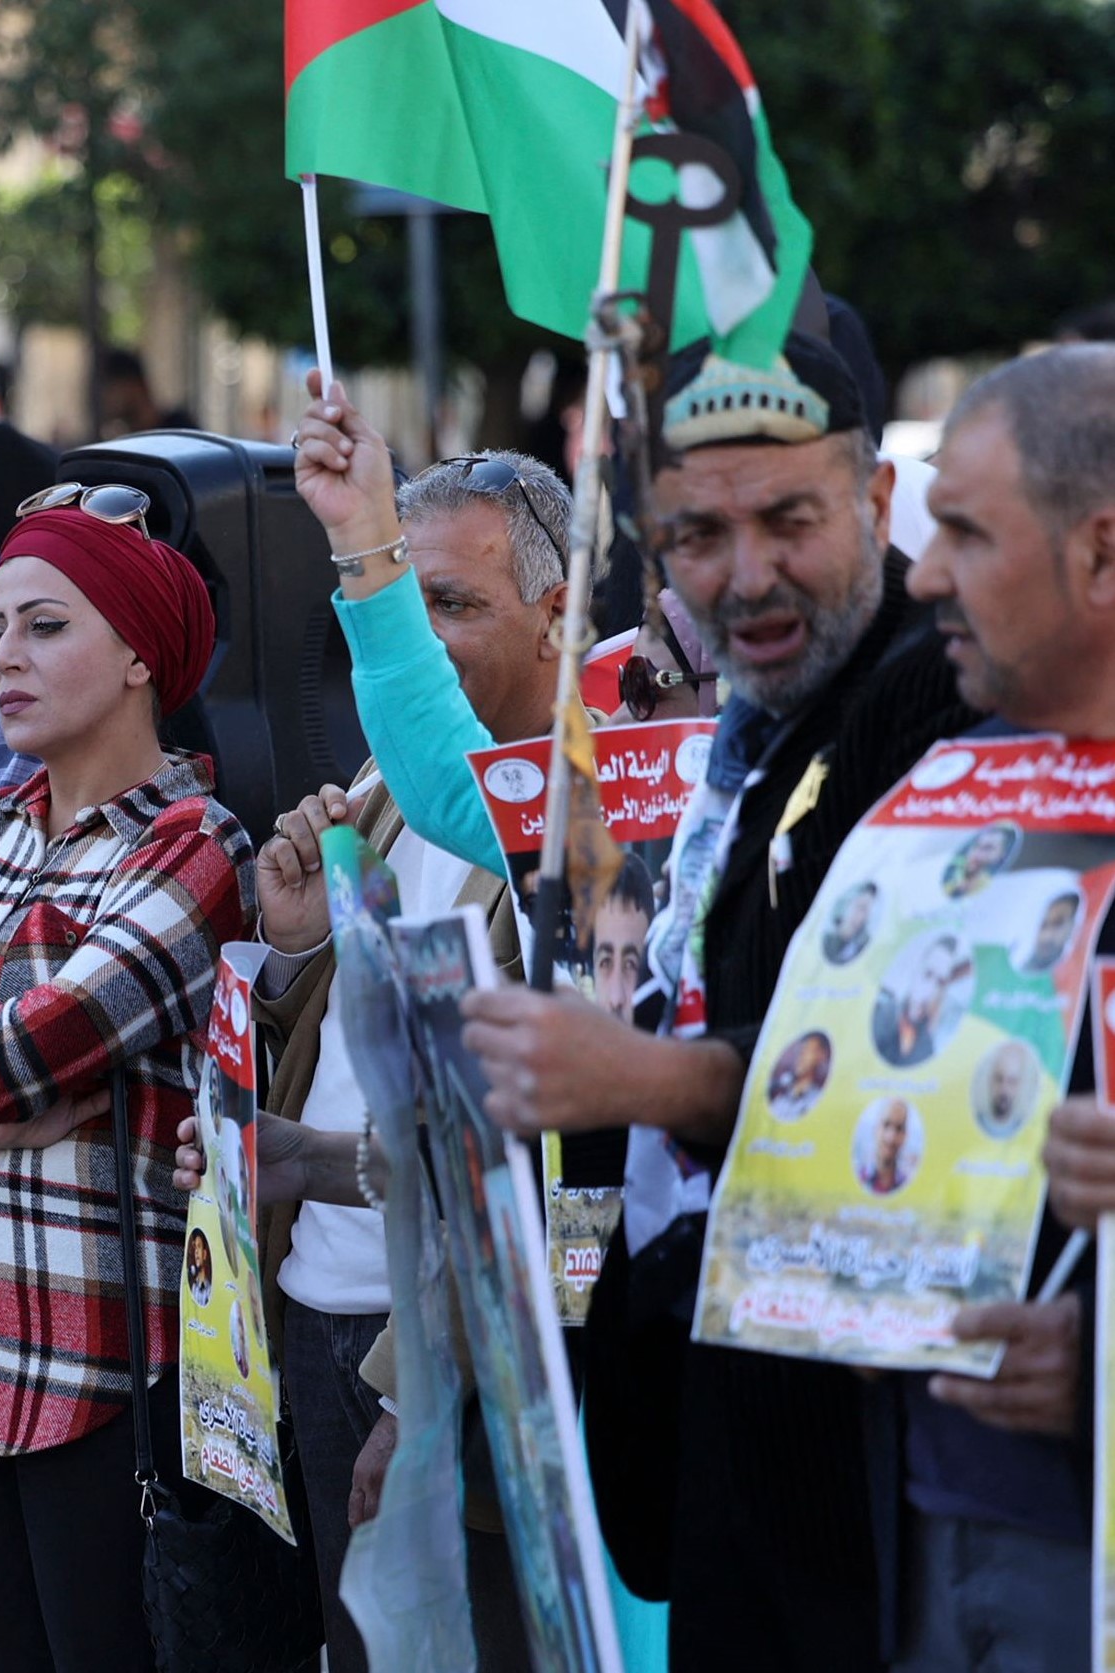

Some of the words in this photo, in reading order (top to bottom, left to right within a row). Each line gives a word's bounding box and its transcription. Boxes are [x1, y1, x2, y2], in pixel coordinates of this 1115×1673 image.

[625, 748, 670, 786] الهيئة
[199, 1395, 238, 1434] الأسرى
[201, 1441, 238, 1481] الطعام
